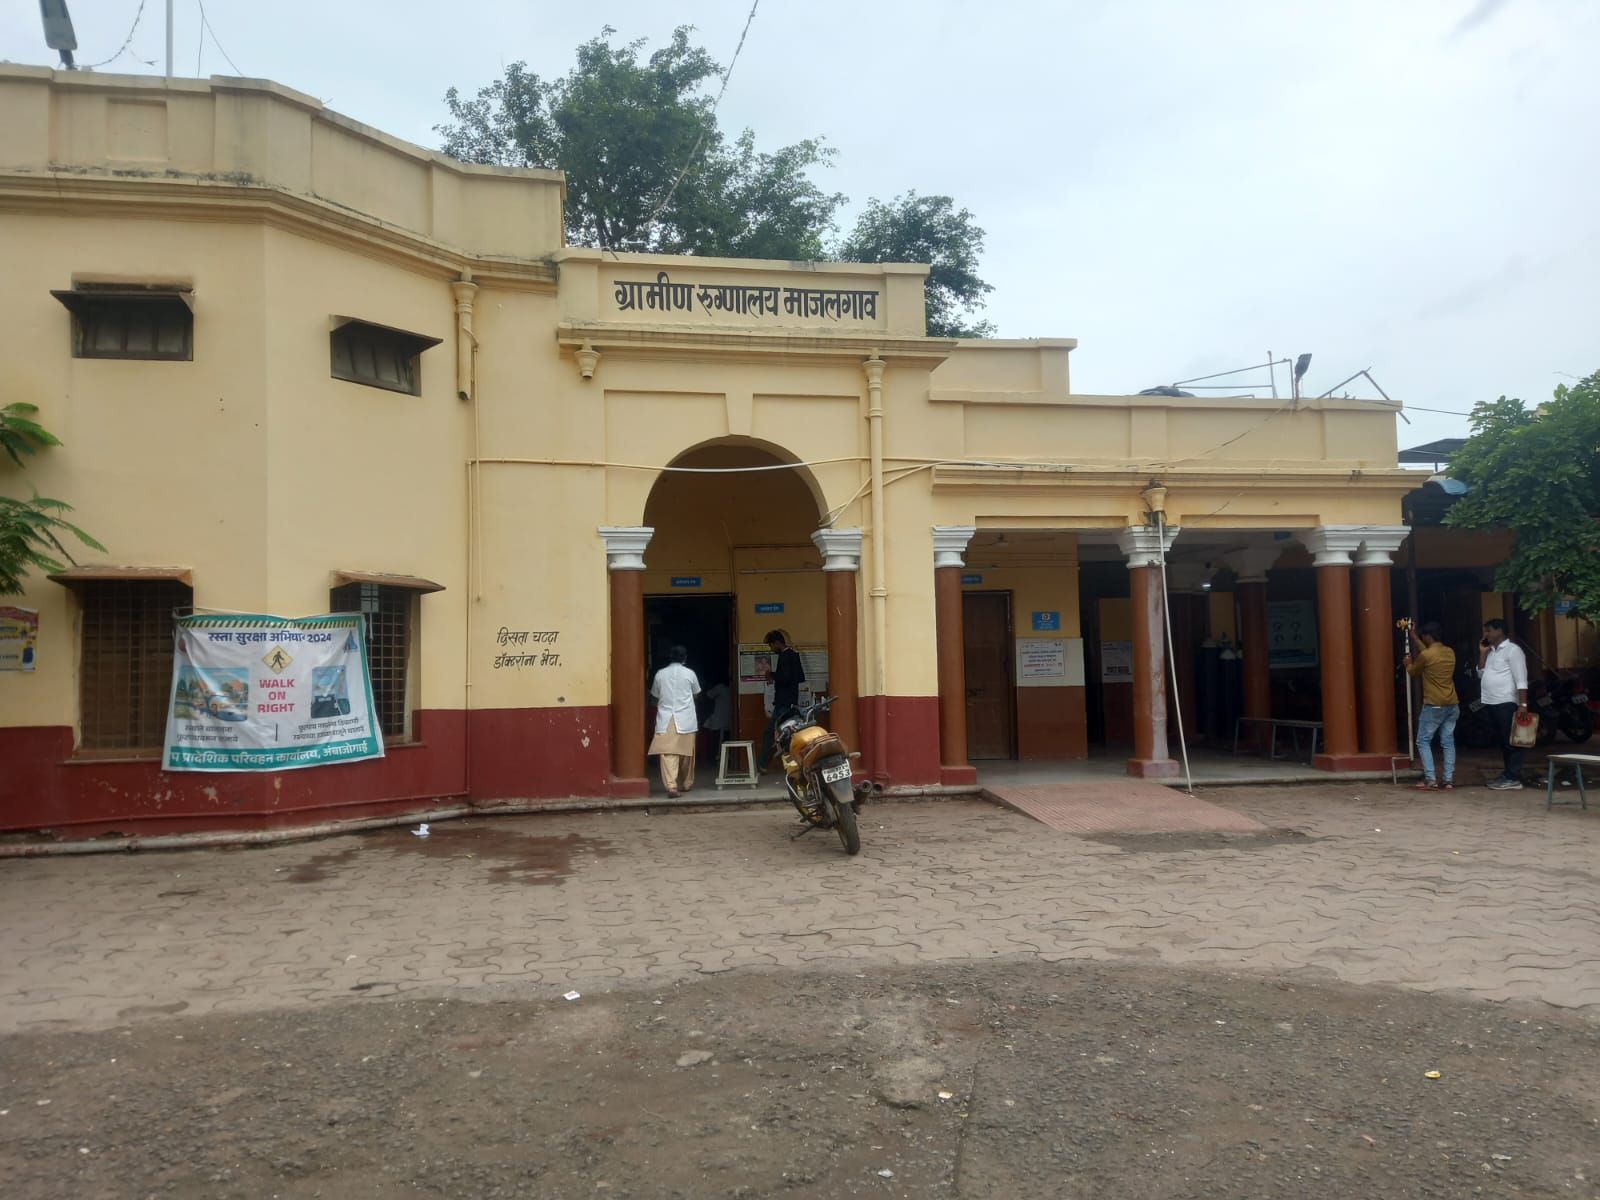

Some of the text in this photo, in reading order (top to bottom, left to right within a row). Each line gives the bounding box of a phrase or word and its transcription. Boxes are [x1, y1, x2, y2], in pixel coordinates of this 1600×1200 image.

[614, 272, 879, 322] ग्रामीण रुग्णालय माजलगाव
[208, 631, 233, 642] रस्ता
[236, 631, 267, 645] सुरक्षा
[307, 633, 332, 644] 2024
[496, 626, 530, 647] दिसता
[259, 678, 295, 689] WALK
[268, 690, 286, 701] ON
[257, 703, 295, 714] RIGHT
[182, 750, 229, 764] प्रादेशिक
[230, 751, 273, 765] परिवहन
[276, 748, 321, 762] कार्यालय,
[323, 740, 368, 757] अंबाजोगाई
